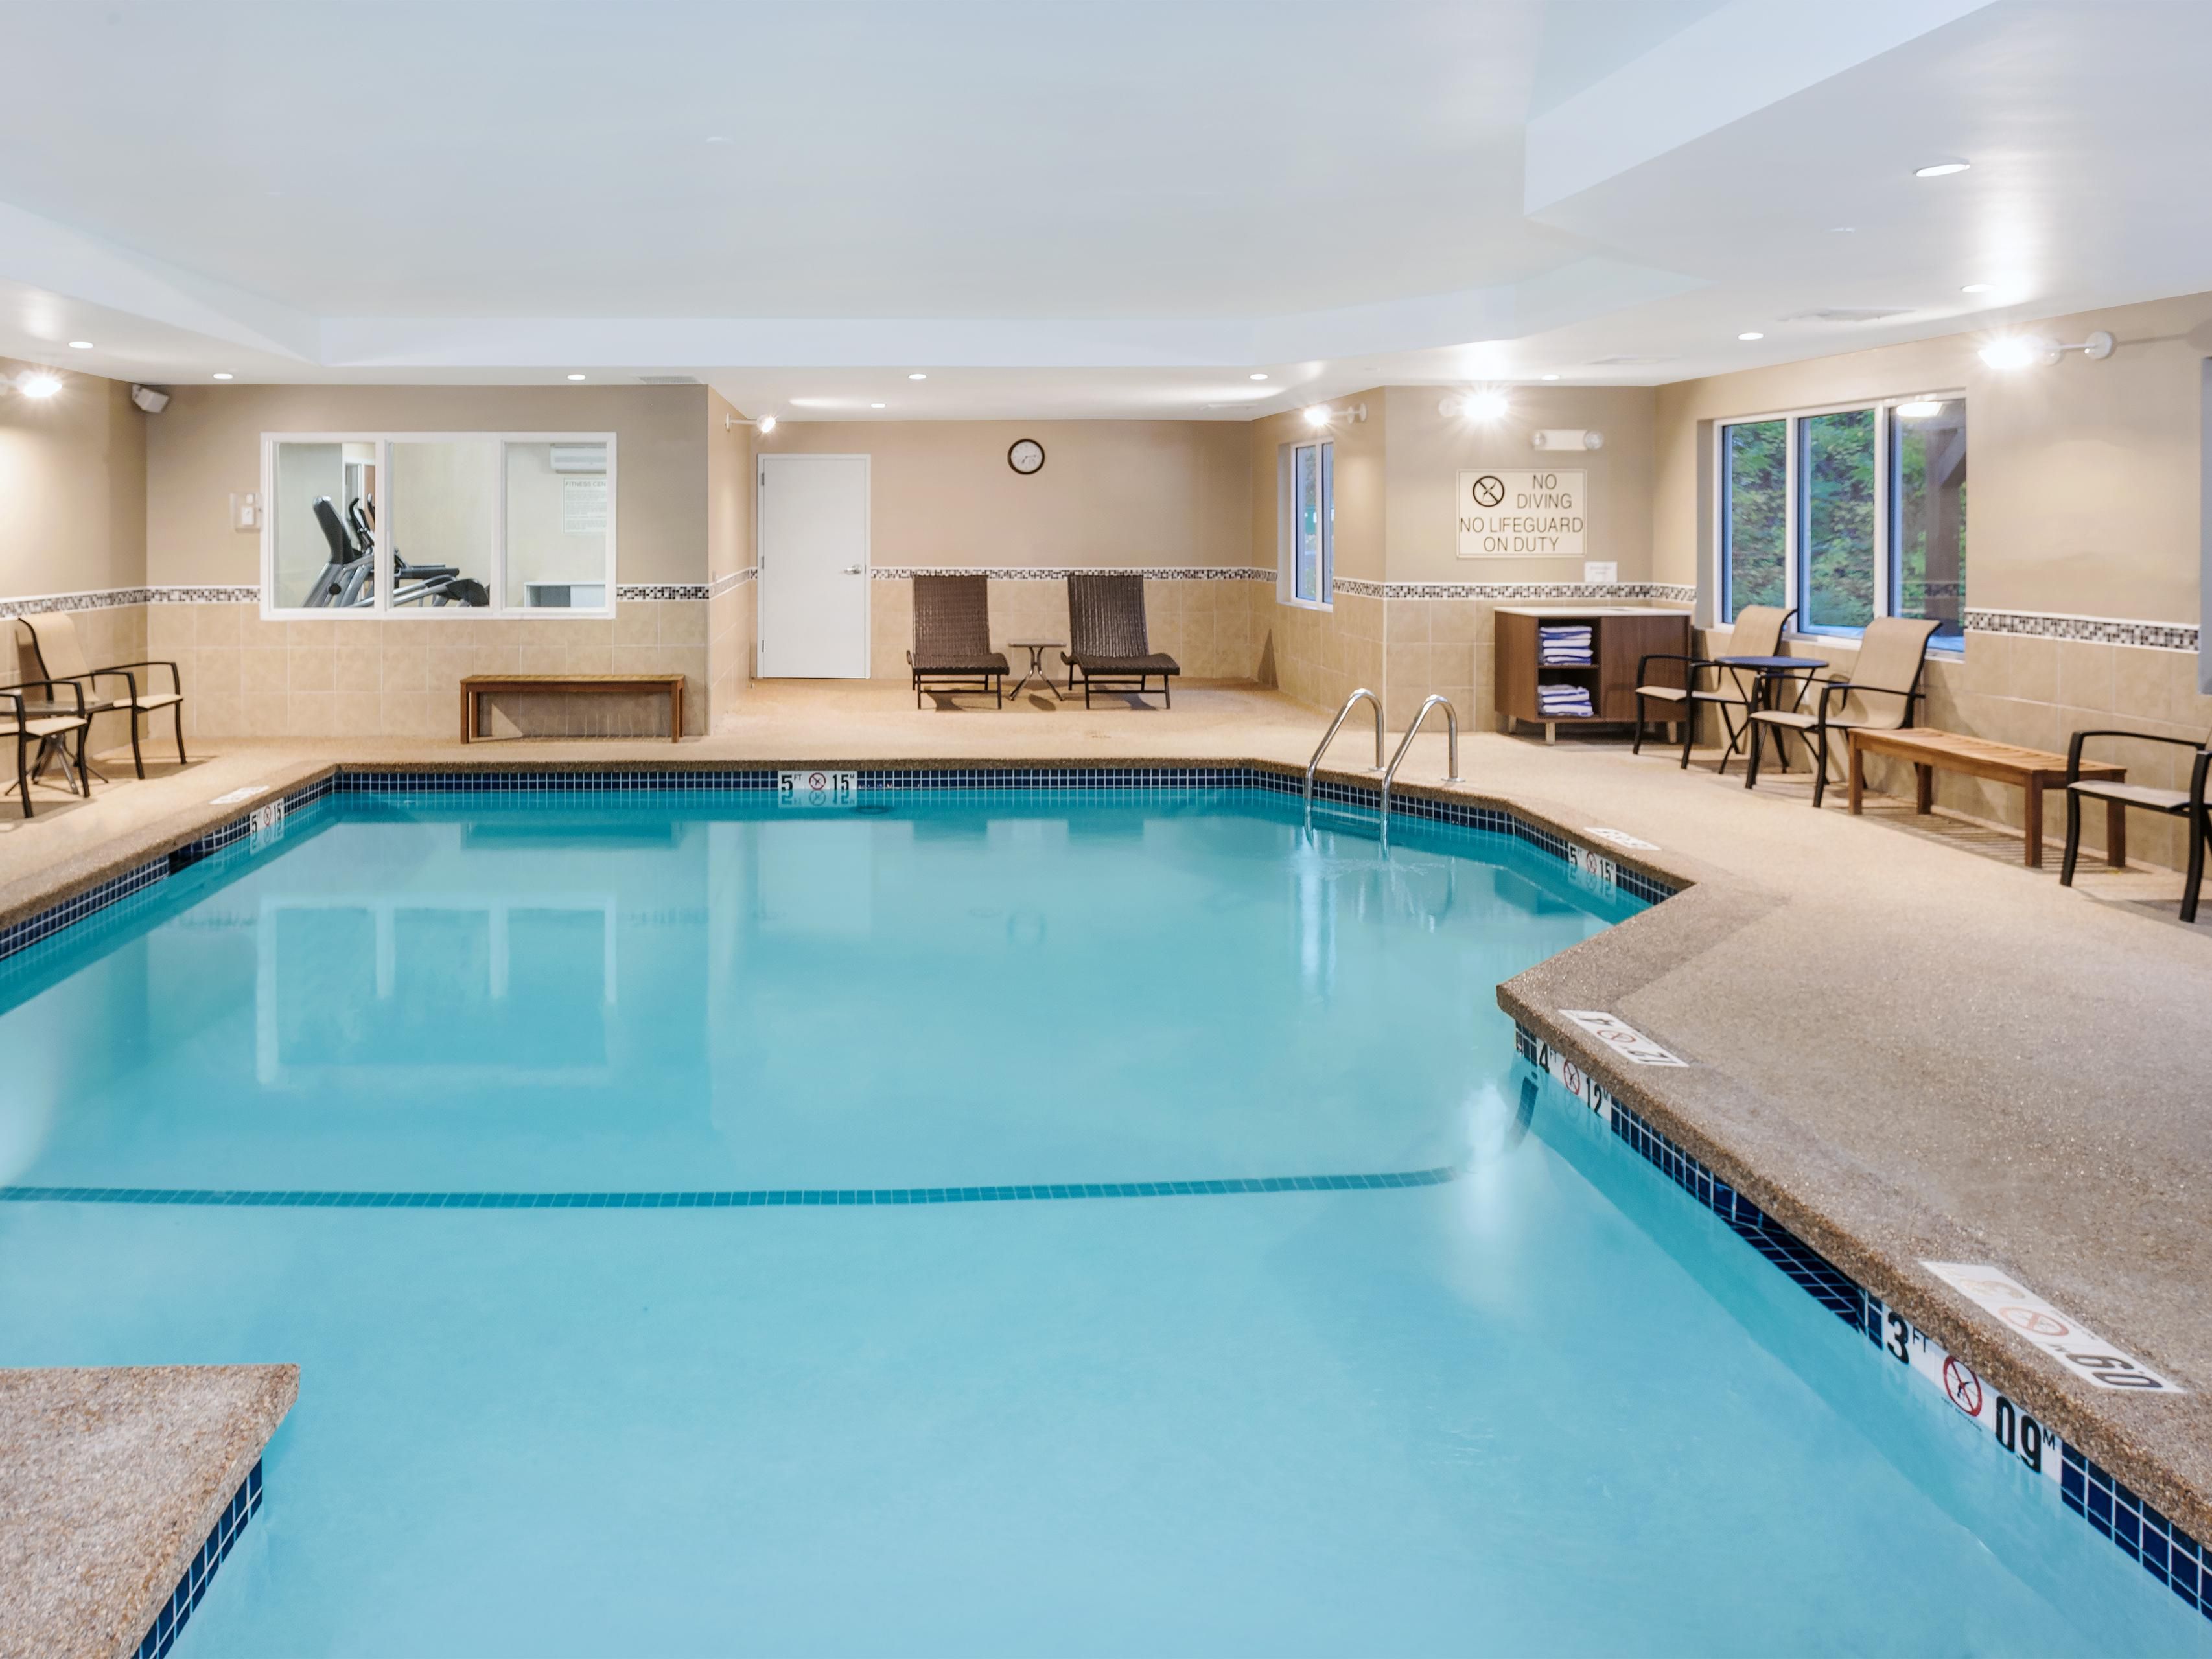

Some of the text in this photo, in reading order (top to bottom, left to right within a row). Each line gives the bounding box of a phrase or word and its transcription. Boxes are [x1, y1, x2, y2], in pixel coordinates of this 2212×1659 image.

[1532, 474, 1557, 490] NO
[1517, 493, 1572, 509] DIVING
[1460, 517, 1584, 533] NO LIFEGUARD
[1484, 537, 1559, 552] ON DUTY
[781, 774, 793, 791] 5
[251, 814, 257, 833] 5
[1570, 846, 1578, 867] 5
[1539, 1042, 1550, 1074] 4
[1887, 1311, 1909, 1365] 3
[1913, 1326, 1929, 1353] FT
[2043, 1428, 2055, 1450] M
